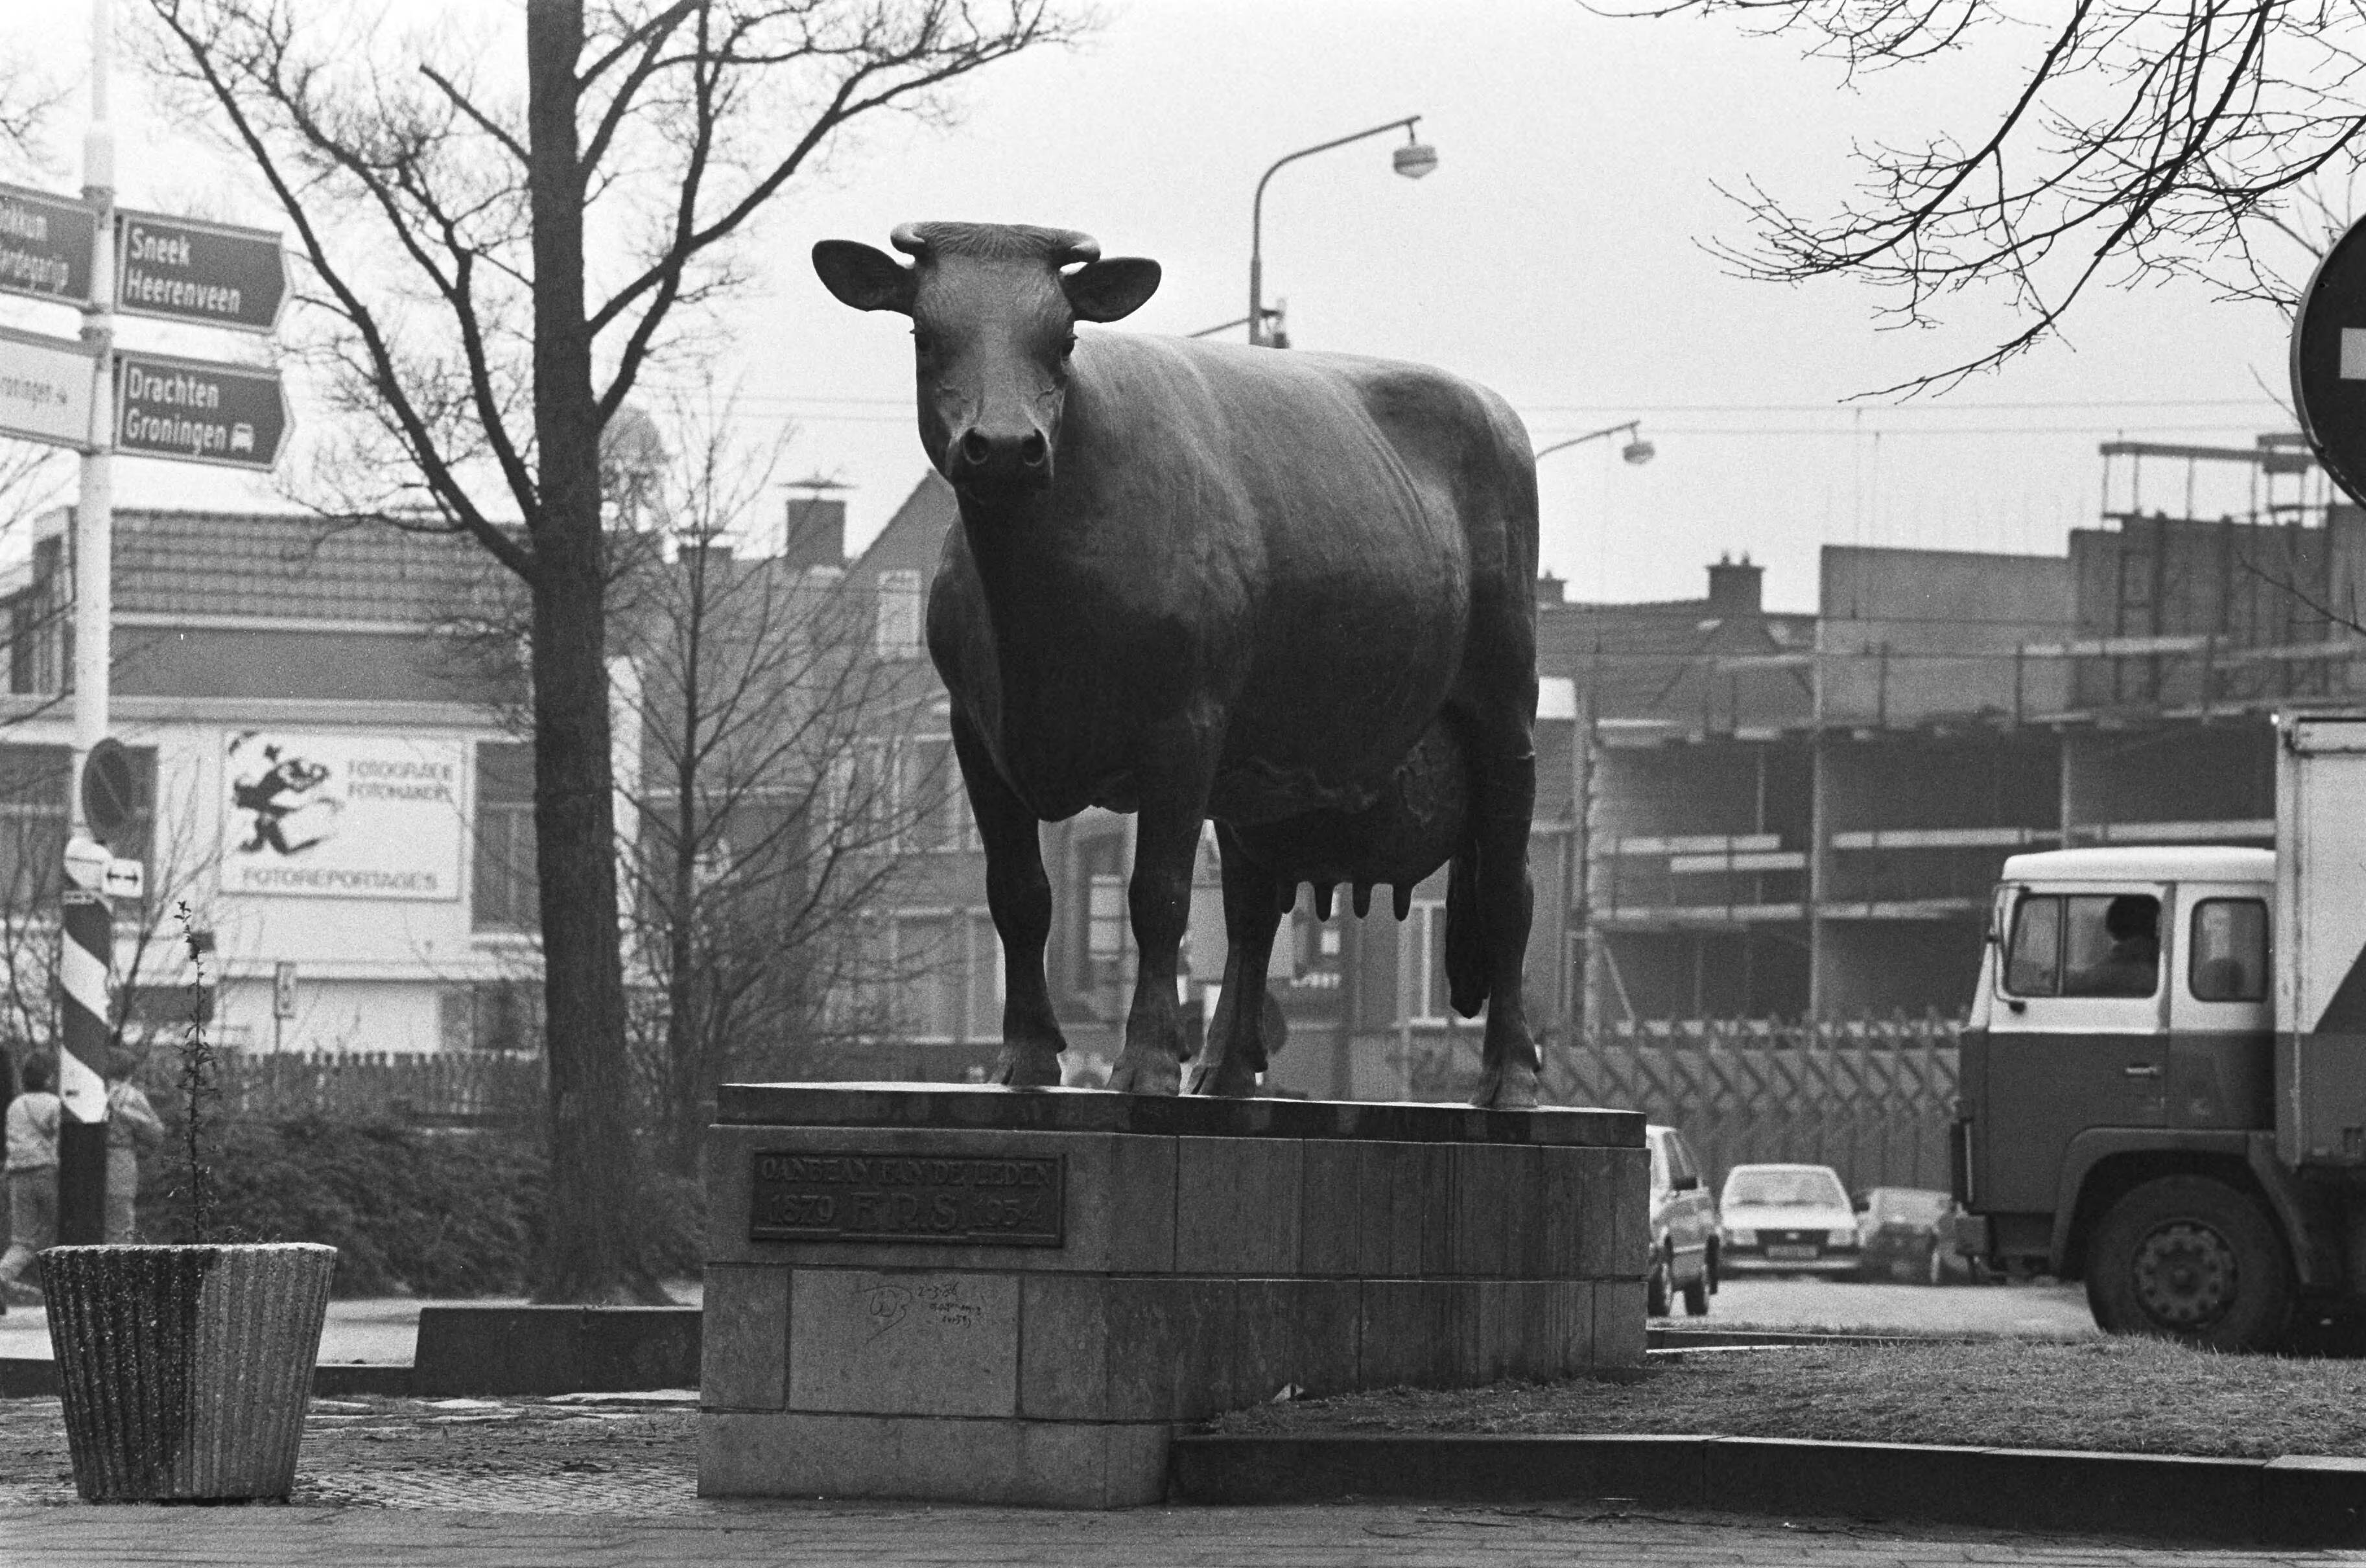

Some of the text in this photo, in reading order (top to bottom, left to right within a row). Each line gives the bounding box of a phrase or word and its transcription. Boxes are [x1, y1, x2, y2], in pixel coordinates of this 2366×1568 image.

[0, 202, 47, 240] okkum
[130, 228, 191, 266] Sneek
[126, 268, 241, 313] Heerenveen
[129, 367, 219, 408] Drachten
[126, 408, 227, 454] Groningen
[244, 869, 437, 889] FOTOREPORTAGES
[973, 1160, 1052, 1186] LEDEN
